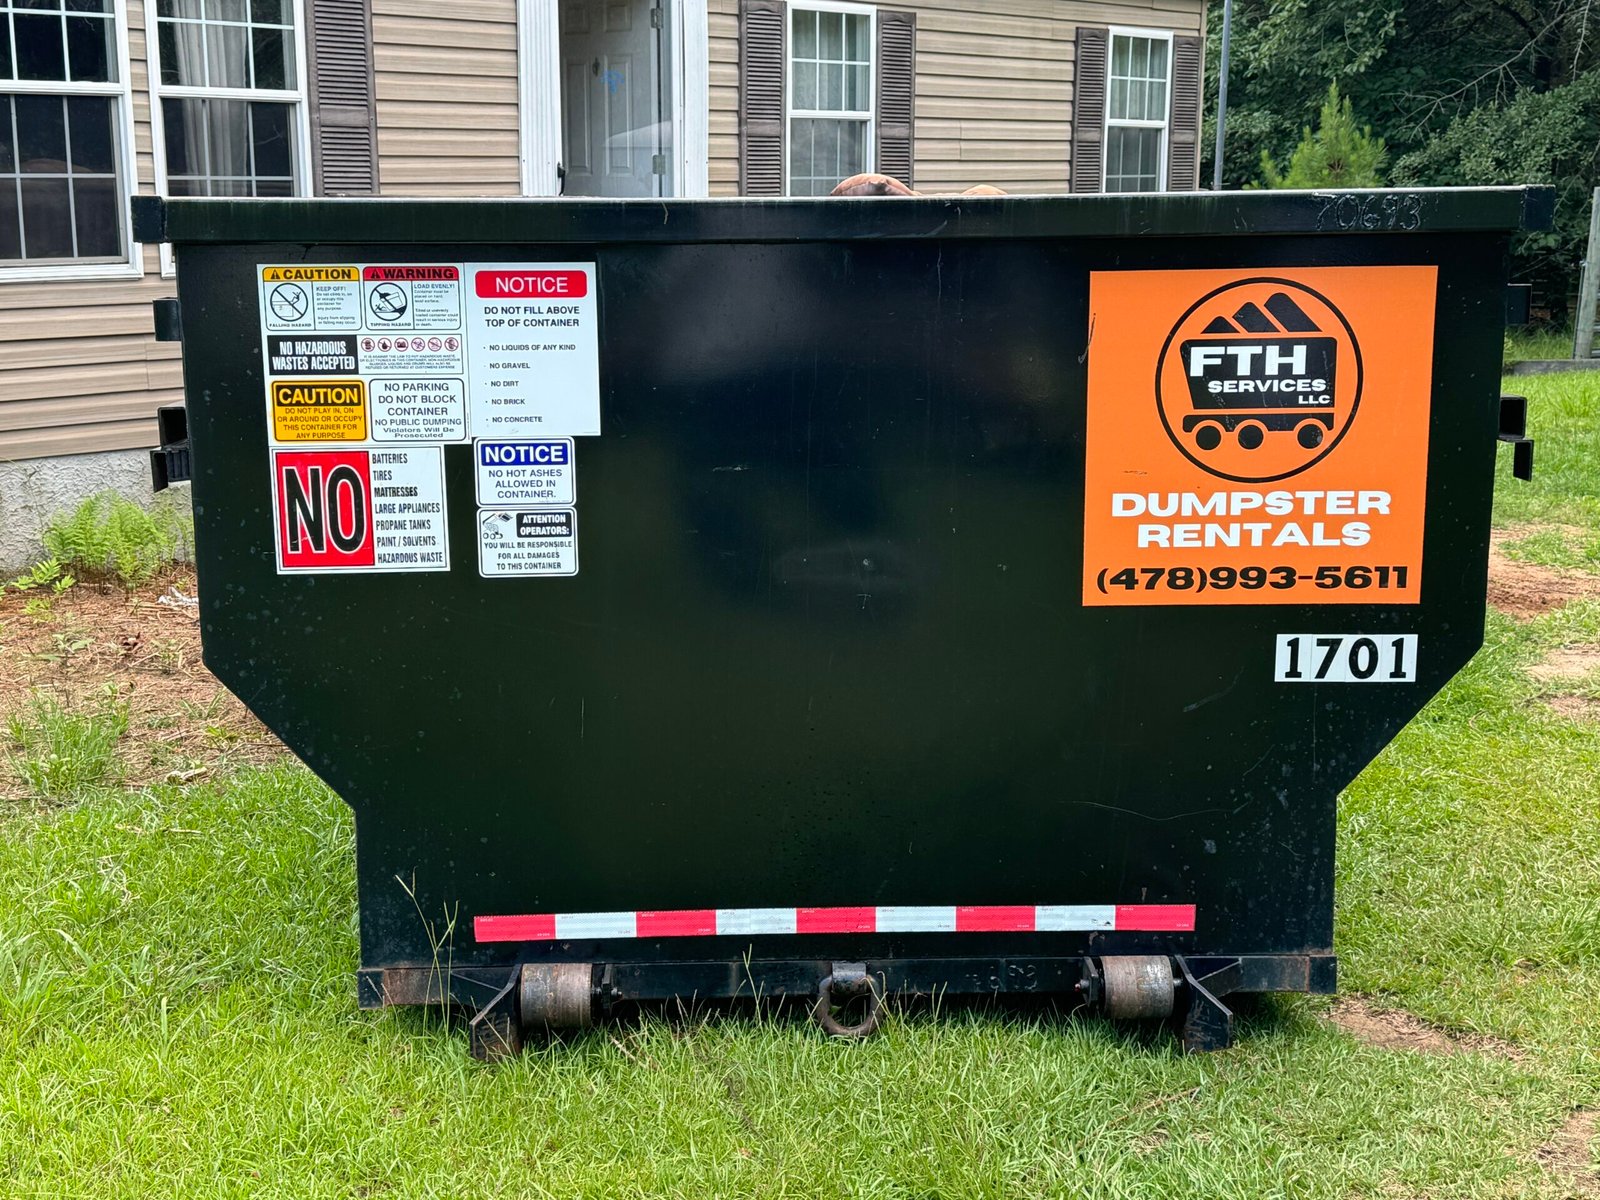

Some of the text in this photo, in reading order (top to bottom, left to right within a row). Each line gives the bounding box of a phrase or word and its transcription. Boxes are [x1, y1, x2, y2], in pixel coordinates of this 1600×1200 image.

[1312, 192, 1422, 230] 70693
[283, 269, 351, 279] CAUTION
[383, 268, 454, 278] WARNING
[496, 277, 569, 293] NOTICE
[279, 341, 346, 355] NO HAZARDOUS
[272, 356, 355, 370] WASTES ACCEPTED
[1189, 344, 1307, 377] FTH
[403, 383, 449, 391] PARKING
[1207, 379, 1327, 394] SERVICES
[278, 388, 358, 404] CAUTION
[378, 395, 456, 404] DO NOT BLOCK
[1298, 394, 1330, 405] LLC
[388, 407, 448, 416] CONTAINER
[372, 454, 408, 464] BATTERIES
[485, 445, 564, 463] NOTICE
[373, 470, 392, 481] TIRES
[530, 469, 562, 477] ASHES
[374, 487, 418, 497] MATTRESSES
[498, 490, 556, 498] CONTAINER.
[282, 464, 367, 554] NO
[375, 503, 440, 514] LARGE APPLIANCES
[1111, 491, 1392, 517] DUMPSTER
[376, 520, 431, 530] PROPANE TANKS
[522, 515, 566, 524] ATTENTION
[520, 526, 570, 535] OPERATORS:
[1137, 522, 1372, 549] RENTALS
[377, 537, 396, 547] PAINT
[403, 536, 436, 546] SOLVENTS
[378, 552, 443, 564] HAZARDOUS WASTE
[1096, 566, 1409, 594] (478)993-5611
[1284, 638, 1408, 679] 1701
